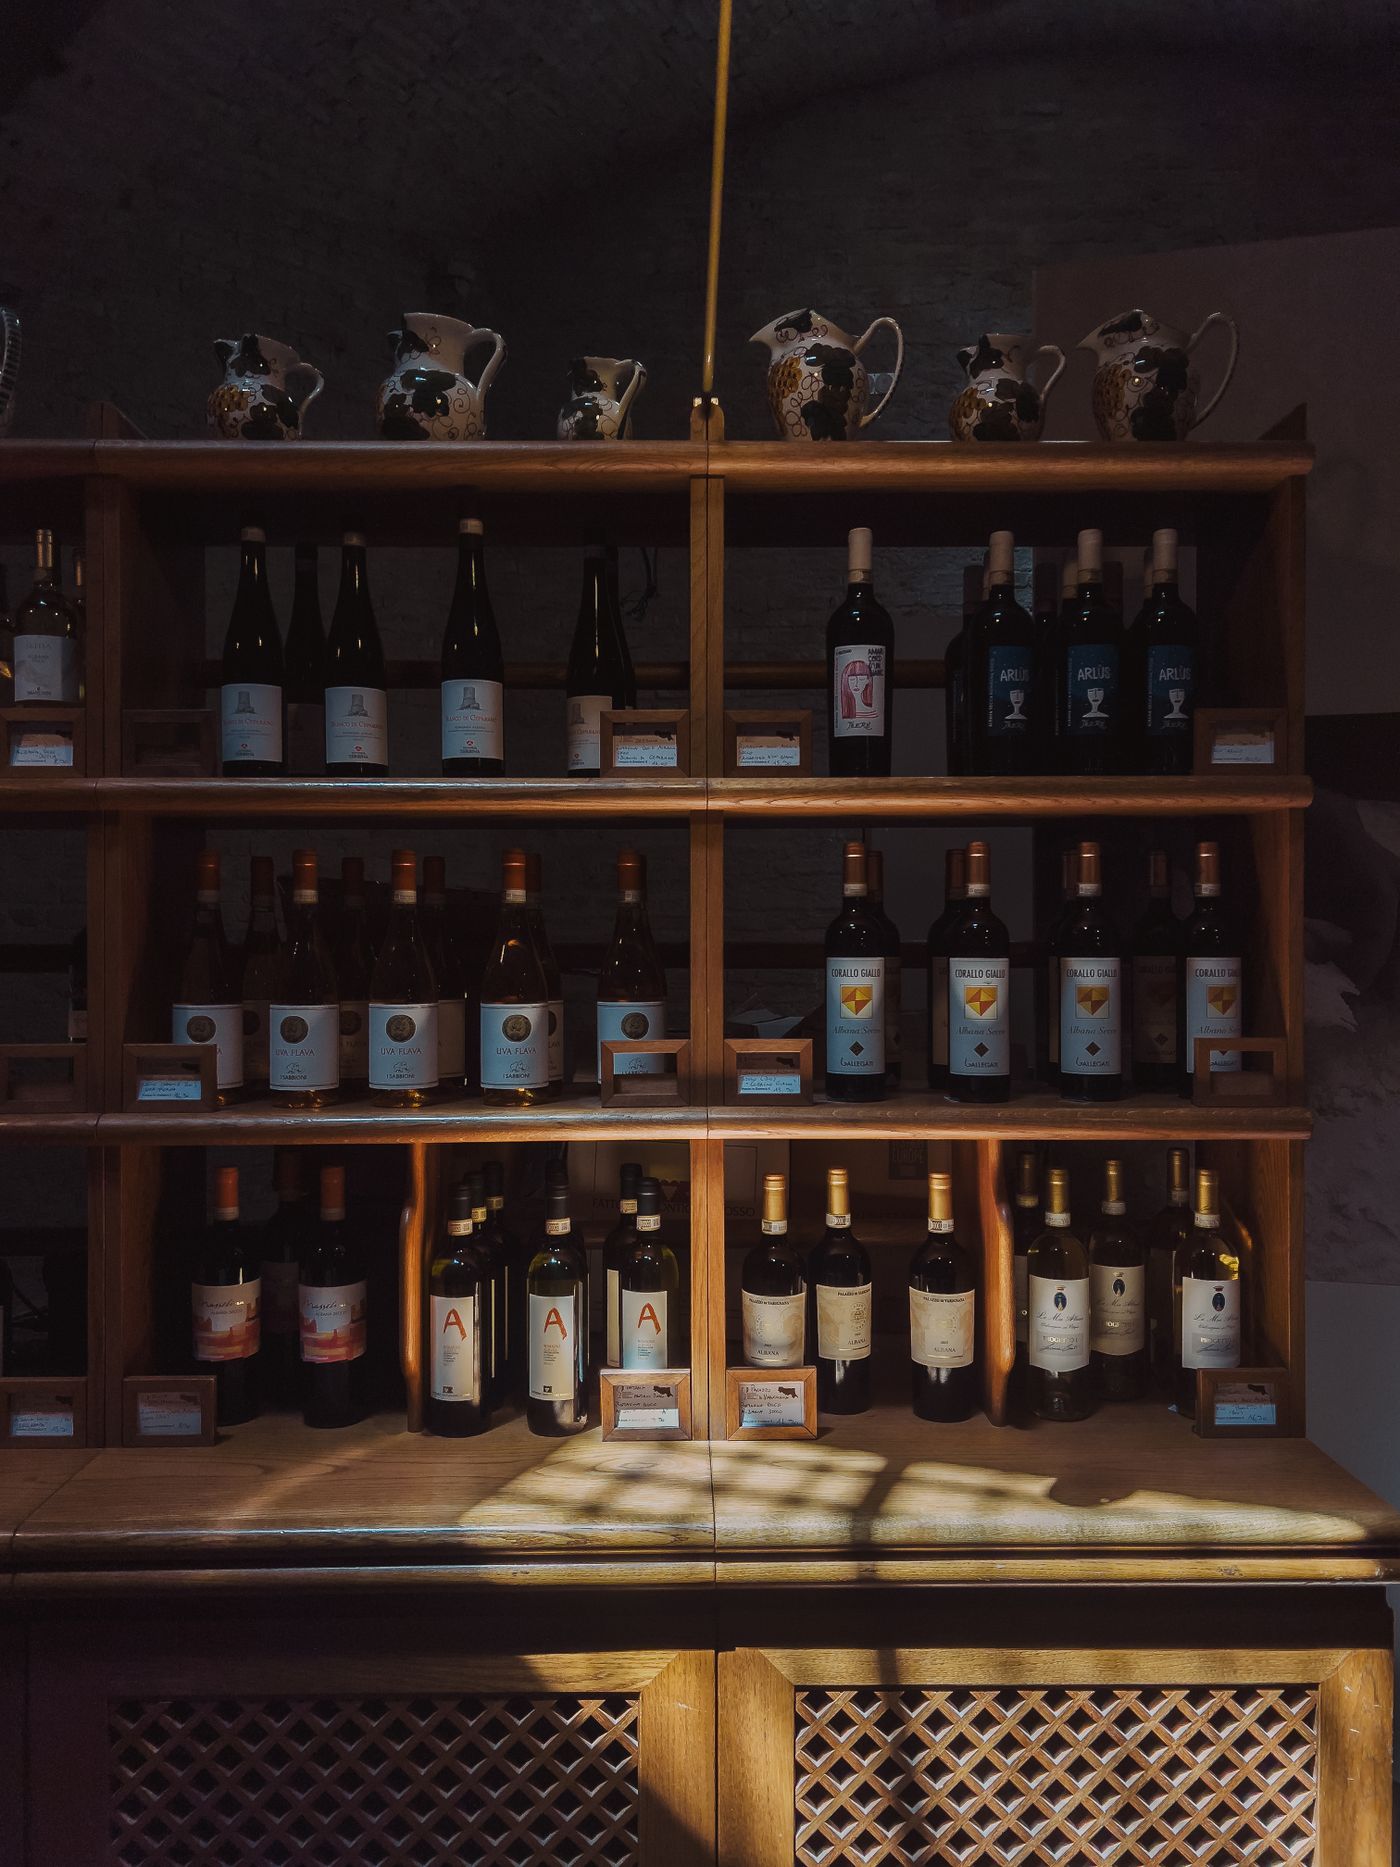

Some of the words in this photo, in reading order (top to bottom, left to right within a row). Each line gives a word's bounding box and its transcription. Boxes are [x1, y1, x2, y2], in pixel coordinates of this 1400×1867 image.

[1077, 664, 1111, 681] ARLÙS
[1158, 664, 1192, 681] ARLÙS
[831, 968, 859, 978] CORALLO
[860, 968, 881, 978] GIALLO
[955, 969, 983, 979] CORALLO
[985, 968, 1006, 978] GIALLO
[1066, 968, 1095, 978] CORALLO
[1097, 968, 1117, 978] GIALLO
[1195, 968, 1226, 978] CORALLO
[275, 1048, 289, 1056] UVA
[291, 1048, 315, 1056] FLAVA
[496, 1047, 512, 1055] UVA
[515, 1047, 537, 1055] FLAVA
[442, 1307, 467, 1342] A
[543, 1307, 568, 1341] A
[637, 1302, 662, 1336] A
